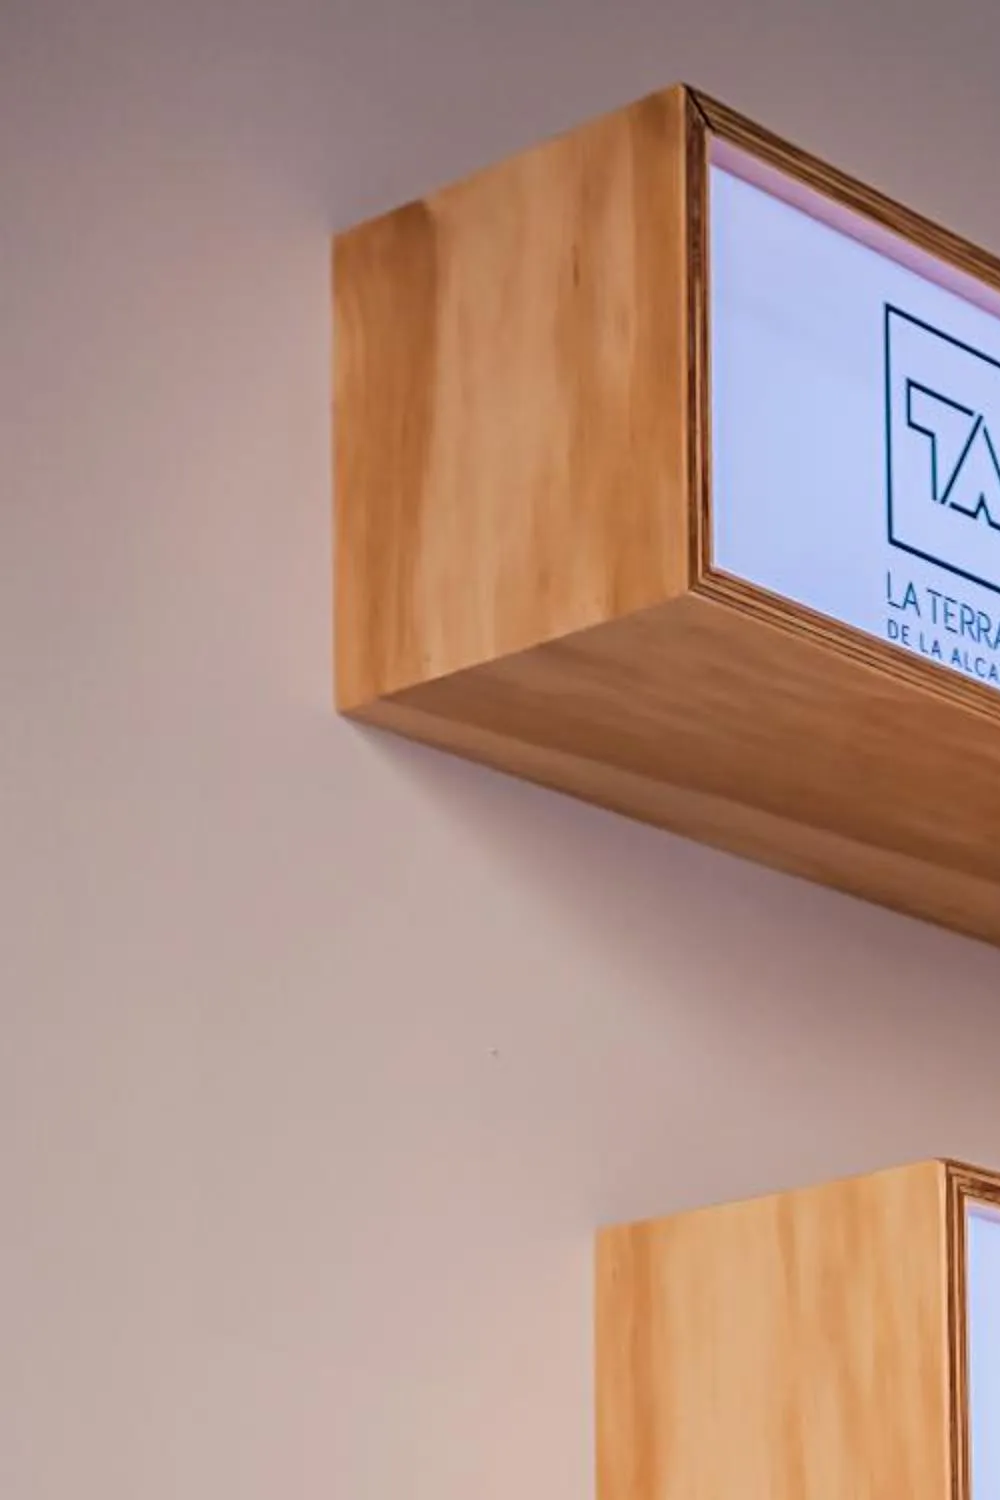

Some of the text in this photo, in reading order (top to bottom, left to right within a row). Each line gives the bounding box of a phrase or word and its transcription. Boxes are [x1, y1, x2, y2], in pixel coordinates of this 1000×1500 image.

[886, 570, 922, 618] LA
[886, 617, 912, 647] DE
[918, 630, 943, 660] LA
